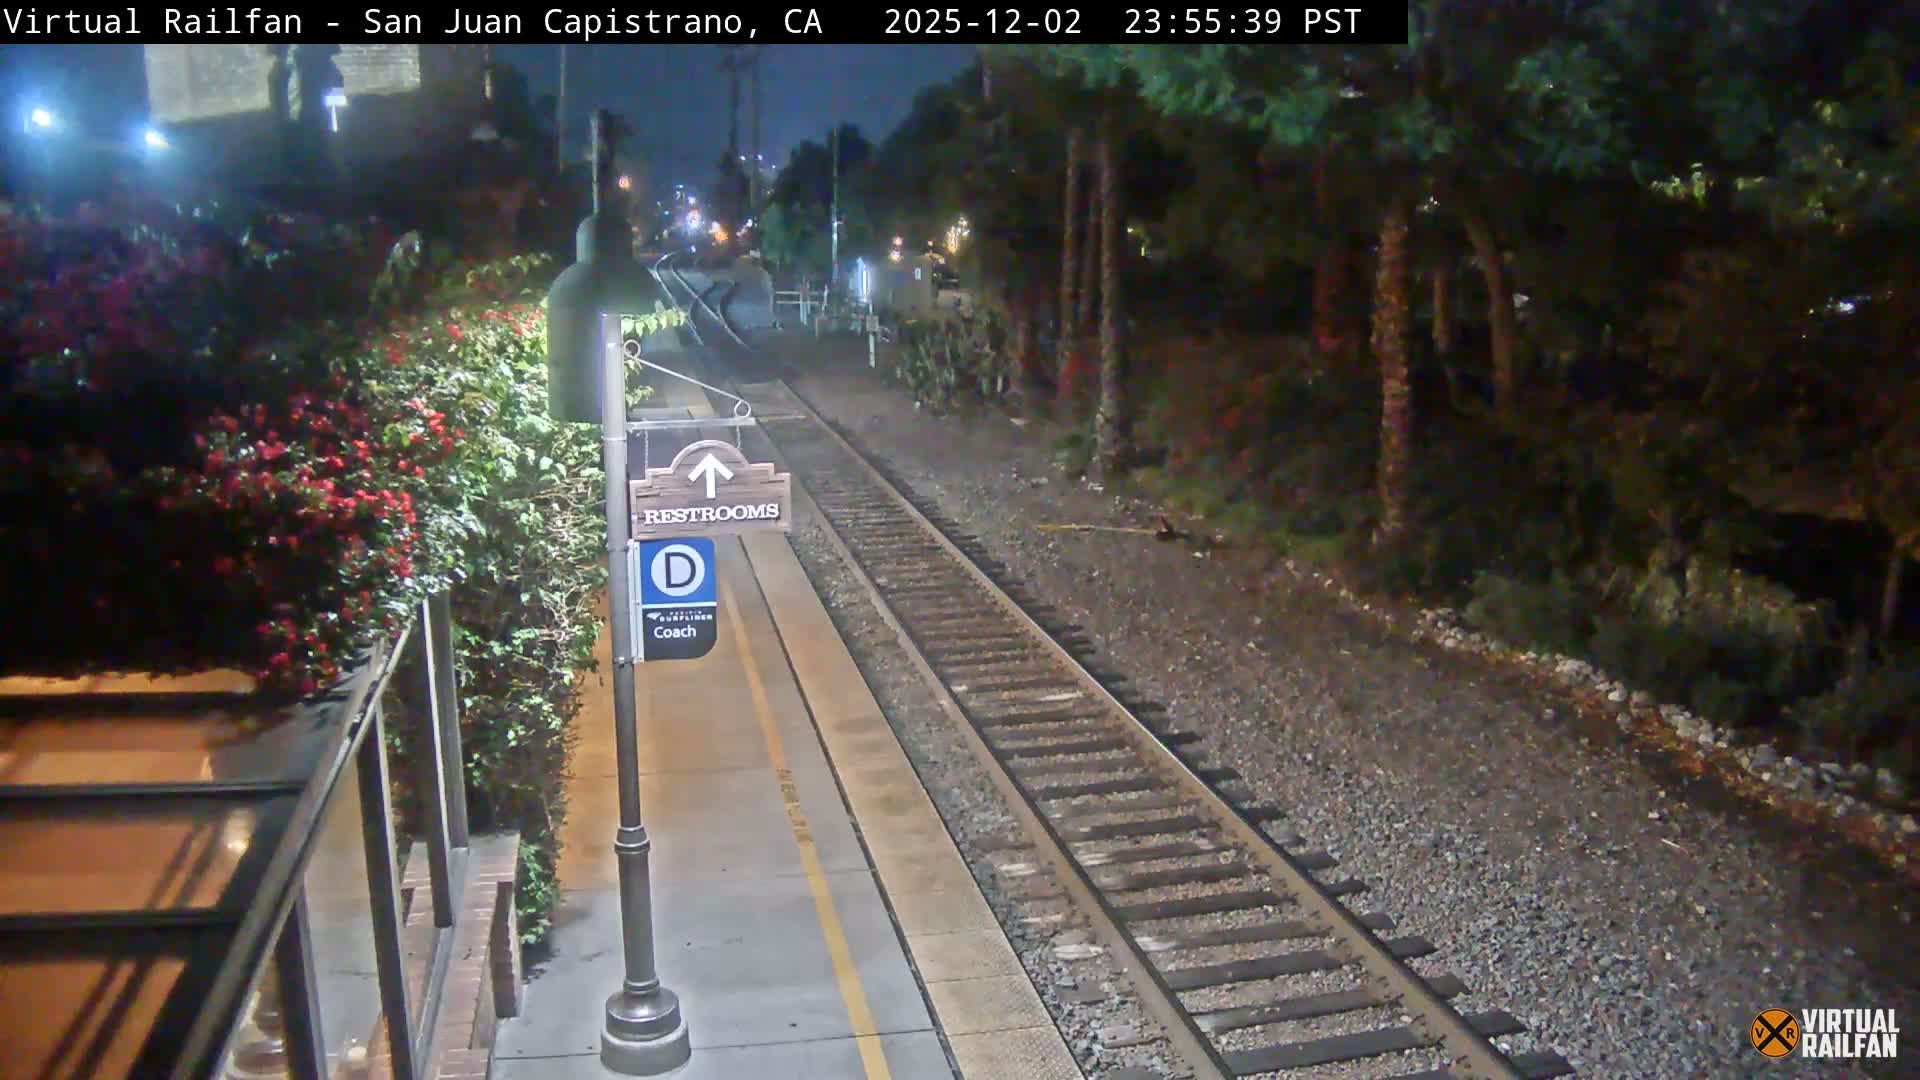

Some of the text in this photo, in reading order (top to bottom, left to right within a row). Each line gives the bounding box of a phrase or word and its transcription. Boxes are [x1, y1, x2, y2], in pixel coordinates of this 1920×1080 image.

[643, 503, 780, 525] RESTROOMS
[664, 551, 697, 589] D
[653, 624, 697, 639] Coach
